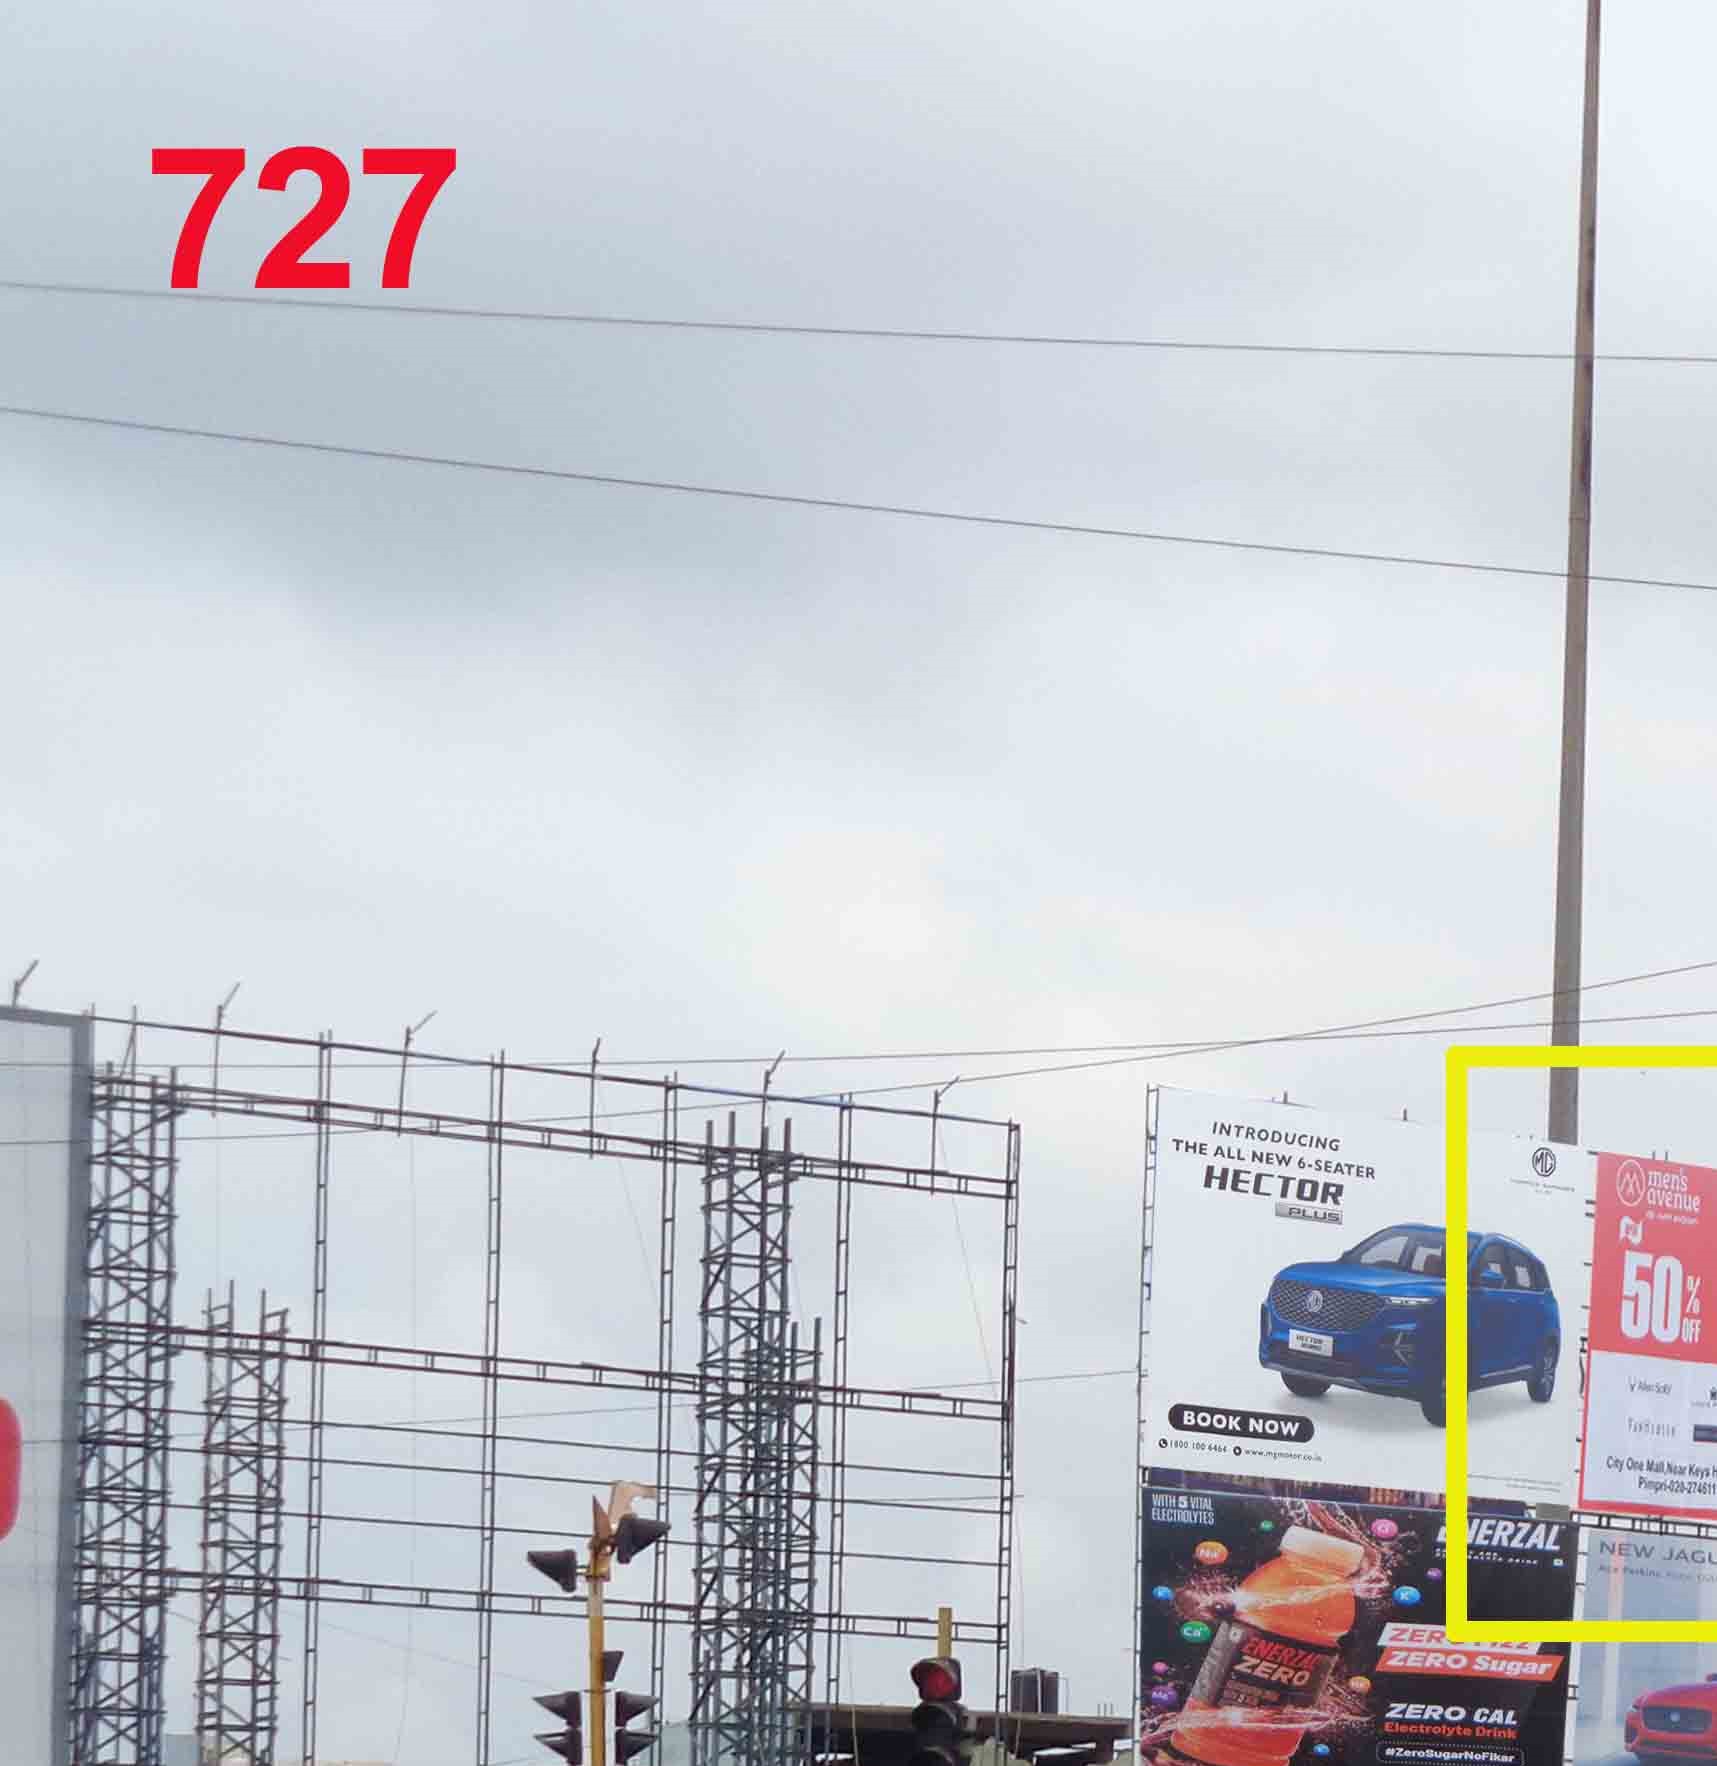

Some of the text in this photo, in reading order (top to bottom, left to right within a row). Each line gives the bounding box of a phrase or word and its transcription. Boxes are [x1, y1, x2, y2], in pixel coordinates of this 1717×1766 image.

[1211, 1121, 1341, 1151] INTRODUCING
[1172, 1138, 1376, 1180] THE ALL NEW 6-SEATER
[1203, 1165, 1344, 1206] HECTOR
[1647, 1187, 1701, 1213] avenue
[1288, 1207, 1340, 1222] PLUS
[1682, 1318, 1702, 1343] OFF
[1183, 1411, 1300, 1437] BOOK NOW
[1606, 1456, 1625, 1473] City
[1626, 1457, 1645, 1471] One
[1152, 1493, 1176, 1508] WITH
[1178, 1495, 1188, 1509] 5
[1600, 1540, 1655, 1559] NEW
[1234, 1655, 1311, 1687] ZERO
[1387, 1651, 1553, 1677] ZERO Sugar
[1385, 1702, 1519, 1726] ZERO CAL
[1384, 1722, 1517, 1740] Electrolyte Drink
[1385, 1746, 1515, 1763] #ZeroSugarNoFikar
